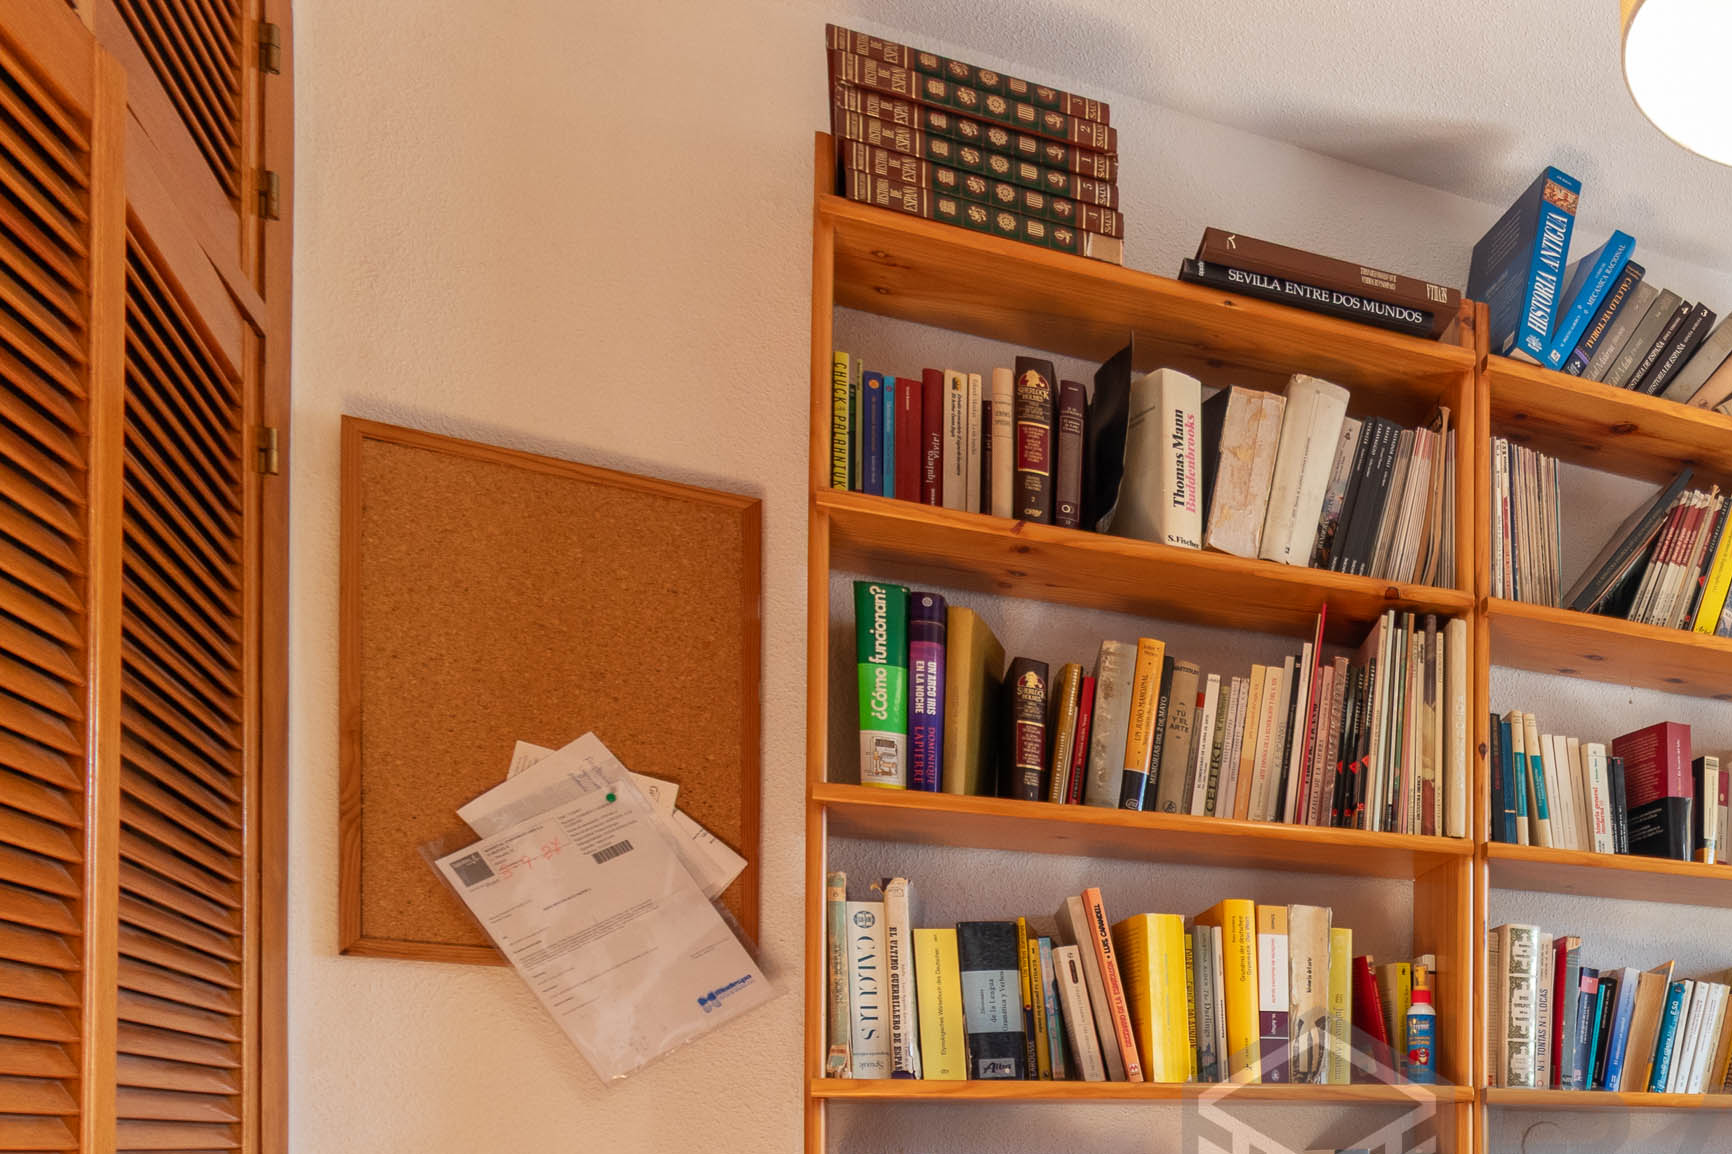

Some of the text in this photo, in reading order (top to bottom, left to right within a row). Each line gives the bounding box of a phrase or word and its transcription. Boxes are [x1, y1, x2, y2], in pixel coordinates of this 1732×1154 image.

[1228, 269, 1423, 323] SEVILLA ENTRE DOS MUNDOS
[1527, 212, 1568, 337] HISTORIA ANTIGUA
[835, 362, 847, 404] CHUCK
[1173, 409, 1185, 509] Thomas Mann
[1185, 412, 1196, 514] Buddenbrooks
[869, 585, 888, 721] ¿Cómo funcionan?
[914, 686, 924, 714] NOCHE
[889, 926, 897, 939] EL
[890, 976, 901, 1033] GUERRILLERO
